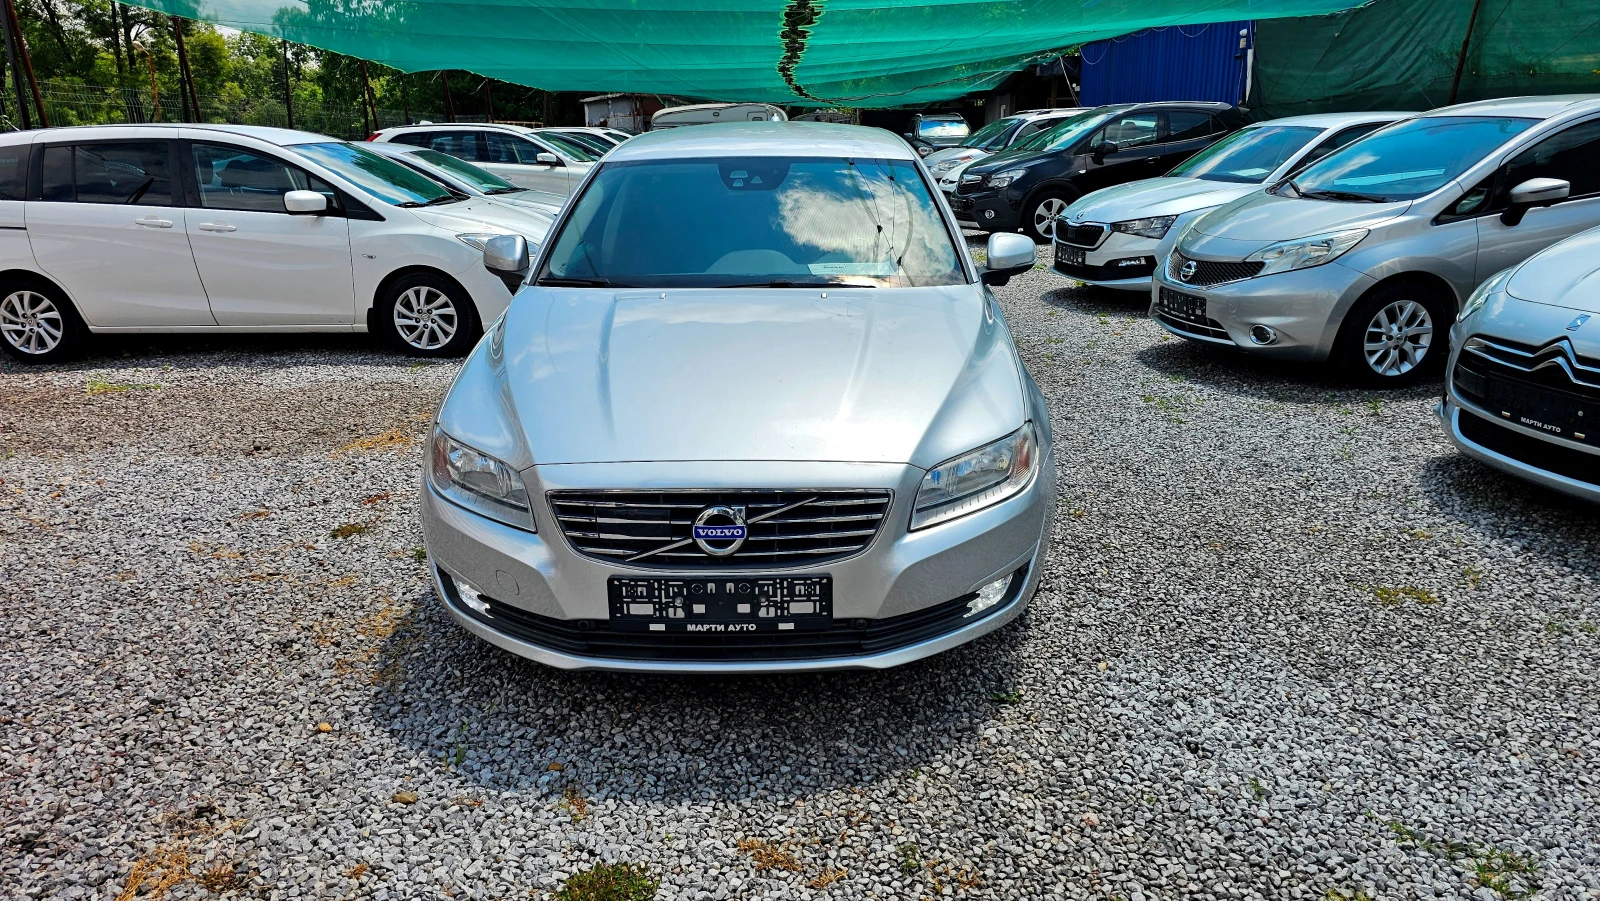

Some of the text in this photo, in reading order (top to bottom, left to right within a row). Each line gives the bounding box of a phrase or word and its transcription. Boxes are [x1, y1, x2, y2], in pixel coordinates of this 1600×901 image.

[1520, 417, 1561, 433] МАРТИ АУТО
[697, 528, 743, 536] VOLVO
[687, 623, 757, 632] МАРТИ АУТО
